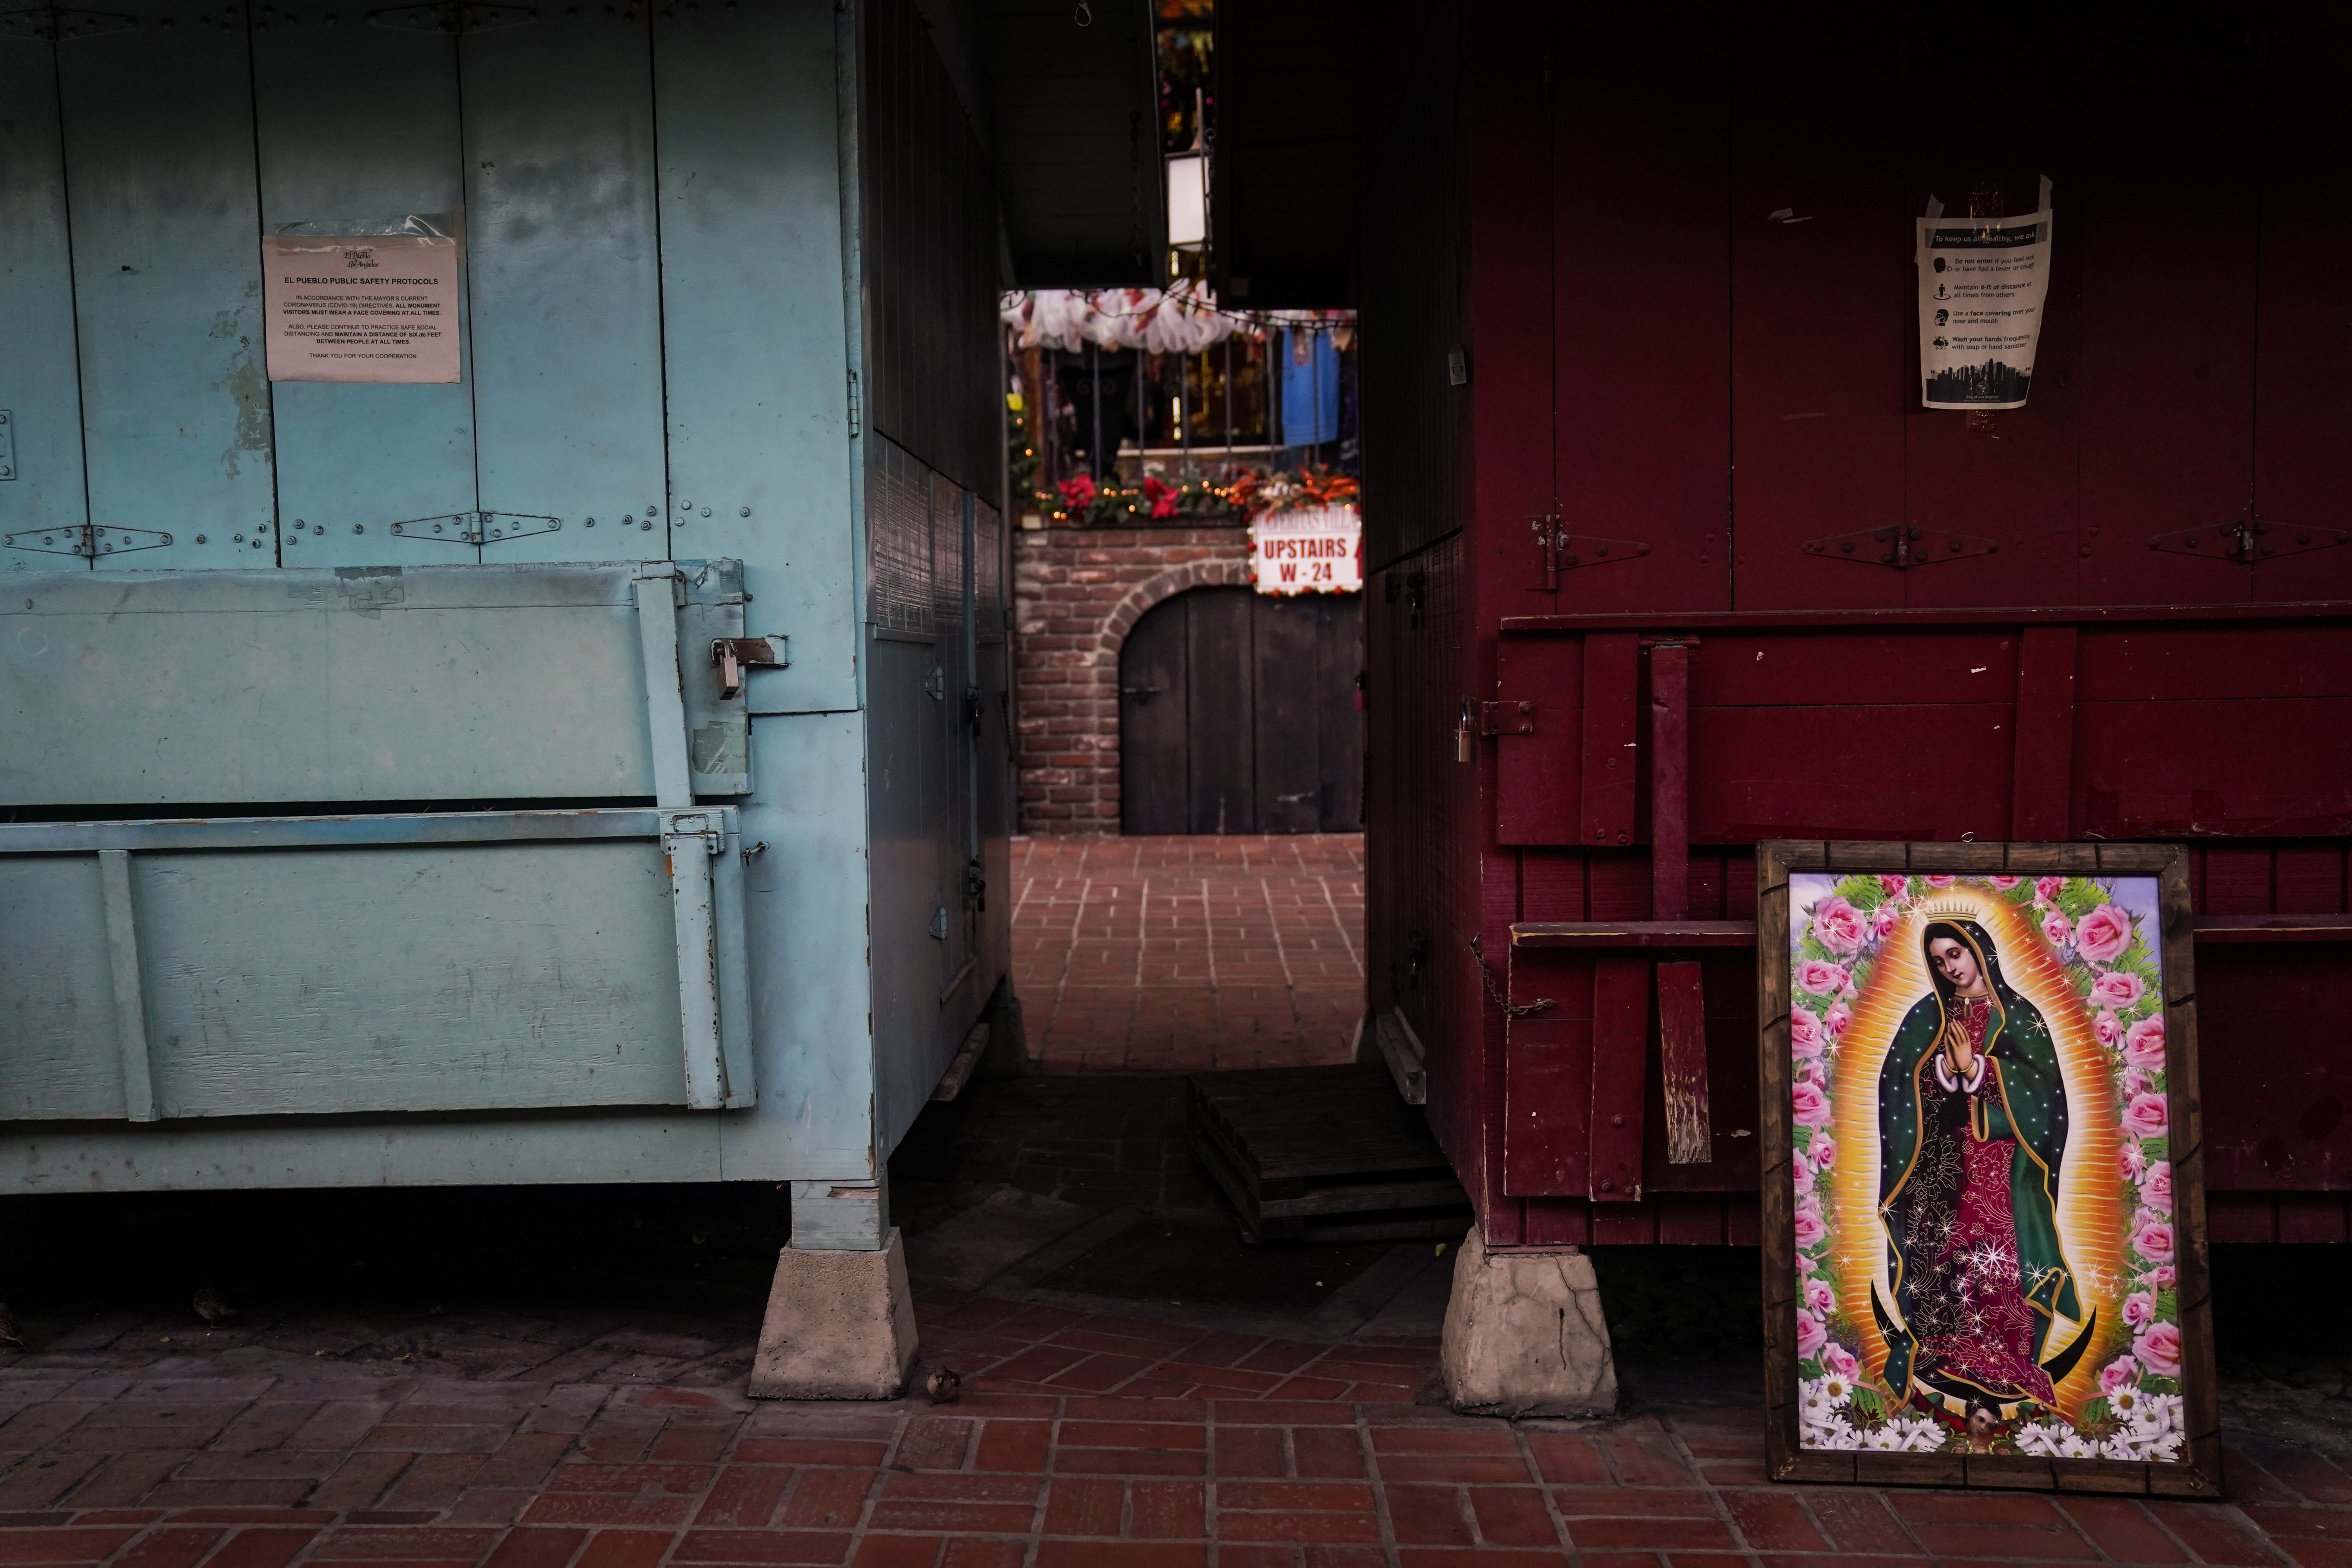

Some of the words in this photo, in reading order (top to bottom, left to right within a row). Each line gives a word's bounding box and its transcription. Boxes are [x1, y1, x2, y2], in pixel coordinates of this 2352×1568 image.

[354, 259, 379, 269] Angeles
[1264, 538, 1347, 559] UPSTAIRS
[1280, 563, 1296, 582] W
[1312, 562, 1332, 581] 24
